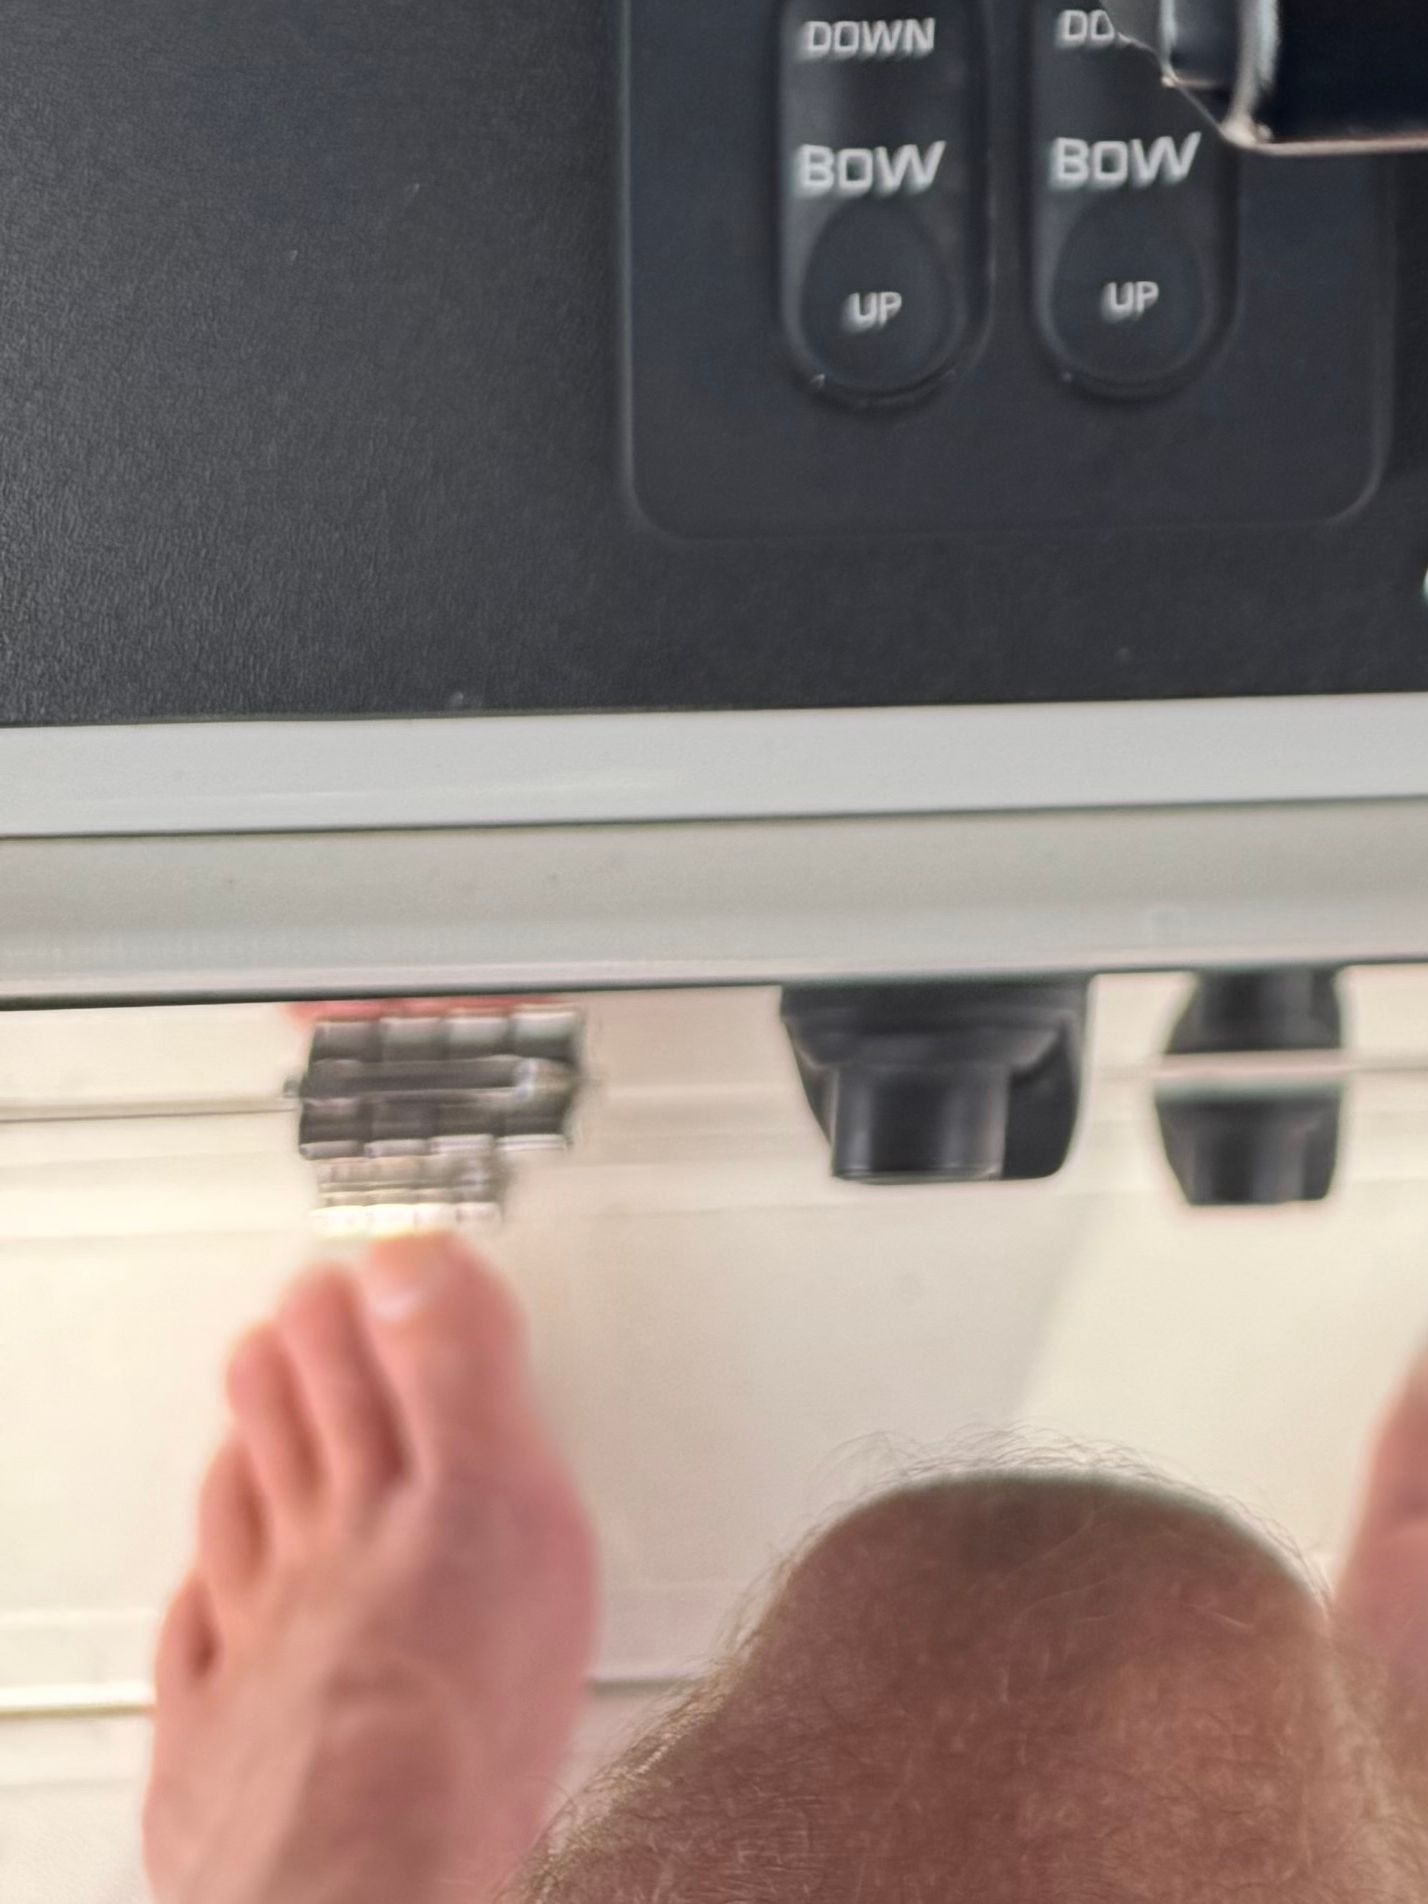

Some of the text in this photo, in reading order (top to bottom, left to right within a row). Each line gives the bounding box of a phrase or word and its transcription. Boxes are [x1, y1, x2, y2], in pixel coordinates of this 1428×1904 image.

[803, 18, 935, 58] DOWN
[1058, 9, 1115, 49] DO
[797, 141, 946, 196] BOW
[1050, 133, 1200, 188] BOW
[843, 291, 902, 333] UP
[1101, 281, 1159, 323] UP
